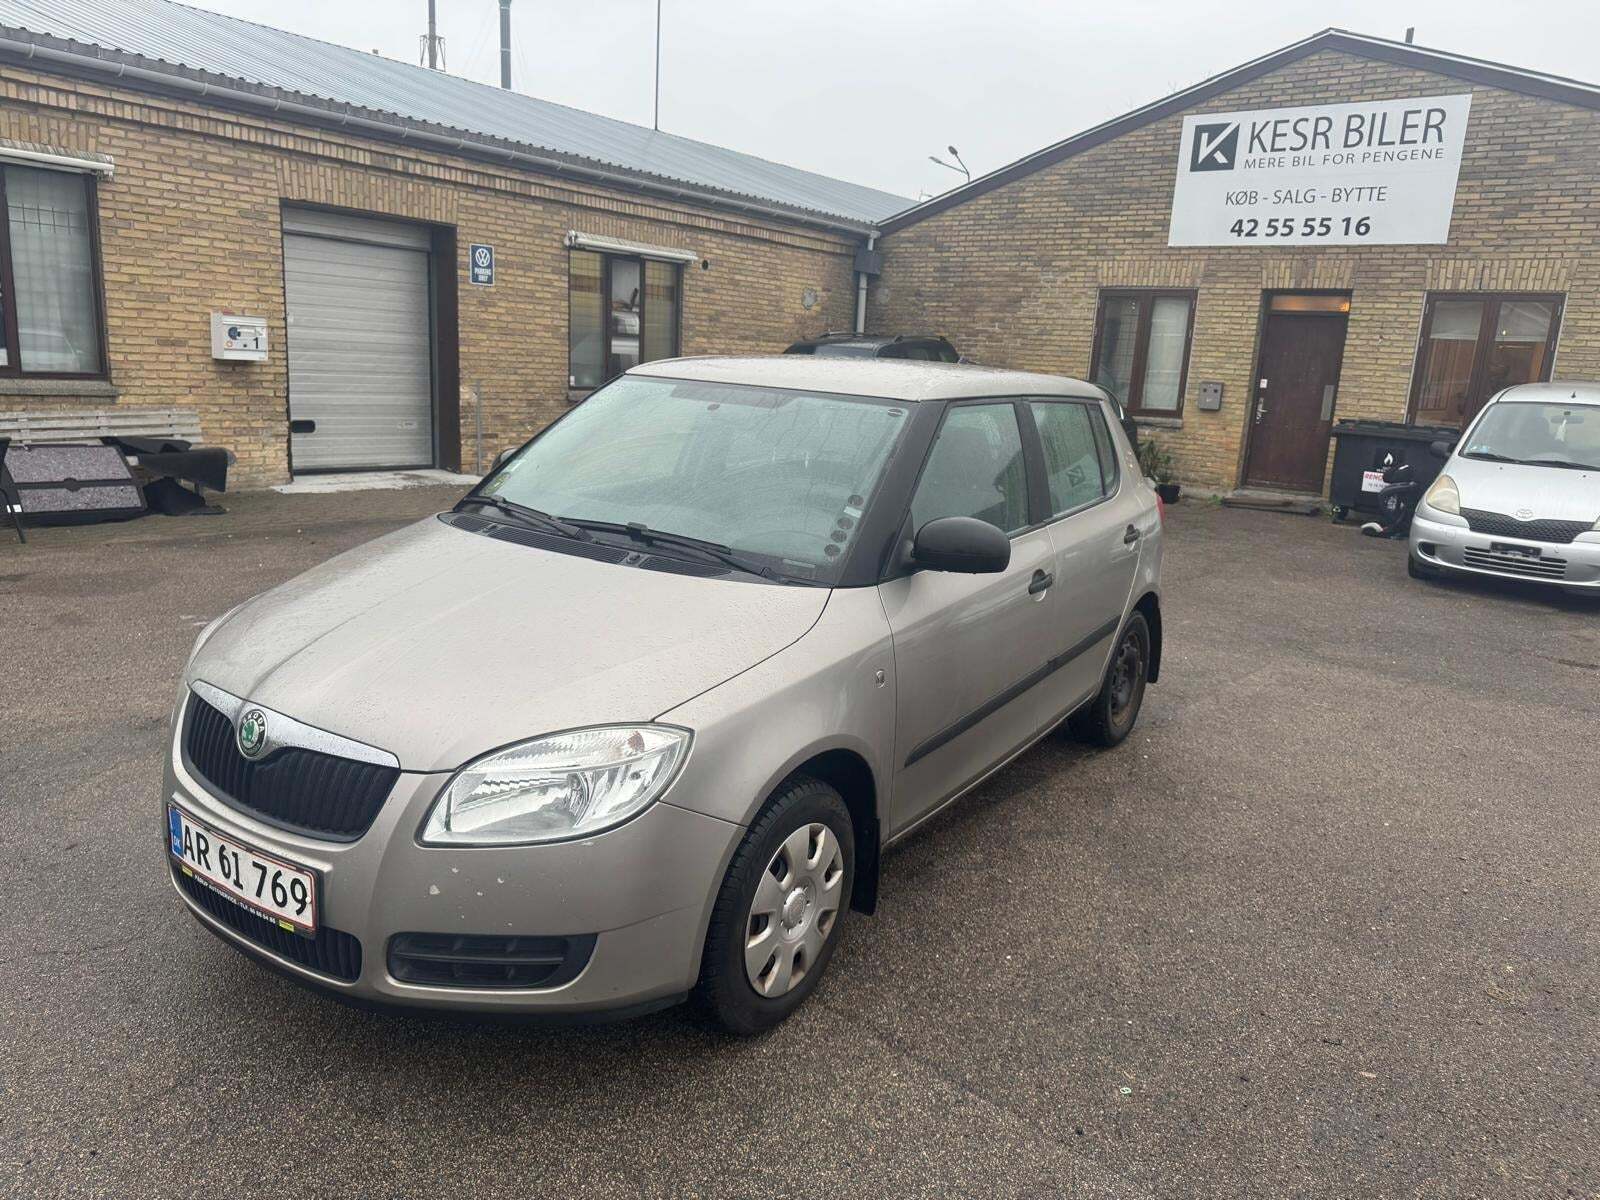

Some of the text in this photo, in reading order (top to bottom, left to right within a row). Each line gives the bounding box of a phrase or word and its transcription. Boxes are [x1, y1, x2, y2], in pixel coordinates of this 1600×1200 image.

[1248, 108, 1447, 154] KESR BILER
[1244, 148, 1444, 169] MERE BIL FOR PENGENE
[1225, 190, 1258, 206] KØB
[1272, 188, 1316, 205] SALG
[1331, 186, 1387, 203] BYTTE
[1230, 216, 1371, 237] 42 55 55 16
[183, 825, 308, 916] AR 61 769
